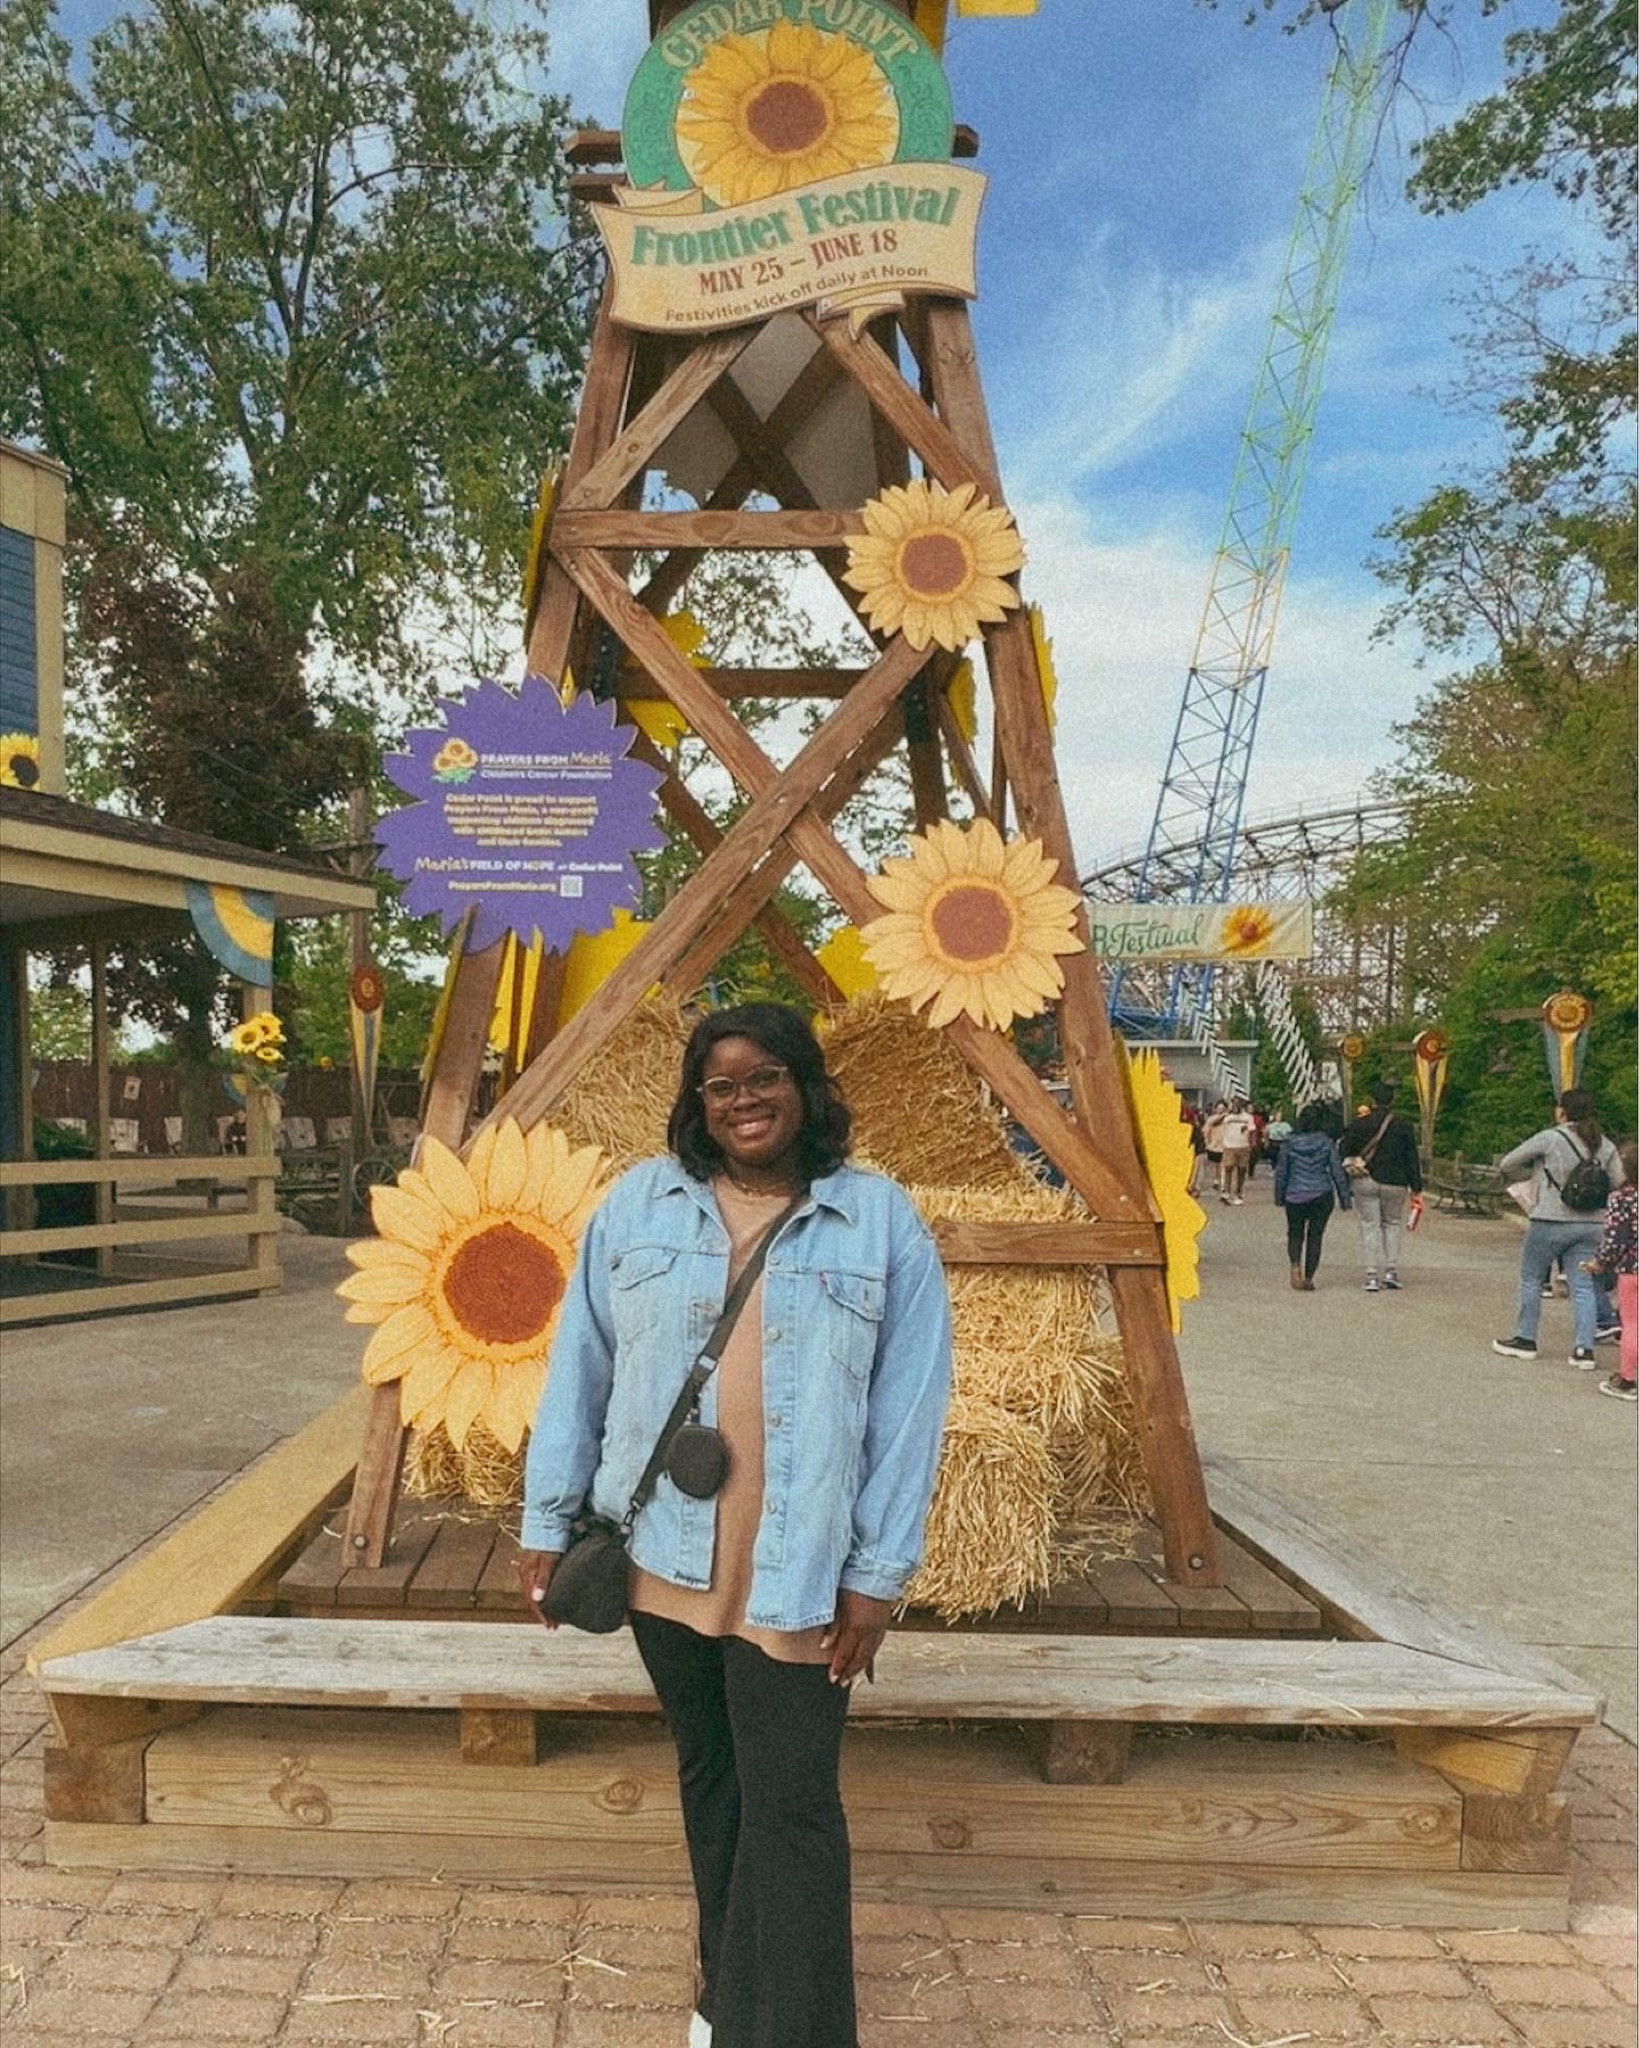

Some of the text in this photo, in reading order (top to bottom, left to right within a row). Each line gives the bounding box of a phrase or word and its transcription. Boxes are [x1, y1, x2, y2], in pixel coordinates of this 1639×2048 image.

[630, 180, 961, 266] Frontier Festival
[699, 265, 744, 296] MAY
[751, 256, 785, 286] 25
[811, 232, 864, 270] JUNE
[870, 228, 898, 254] 18
[665, 263, 929, 322] Festivities kick off daily at Noon
[535, 754, 569, 767] FROM
[470, 860, 504, 871] FIELD
[505, 860, 521, 871] OF
[522, 861, 554, 871] HOPE
[1106, 913, 1204, 958] Festival
